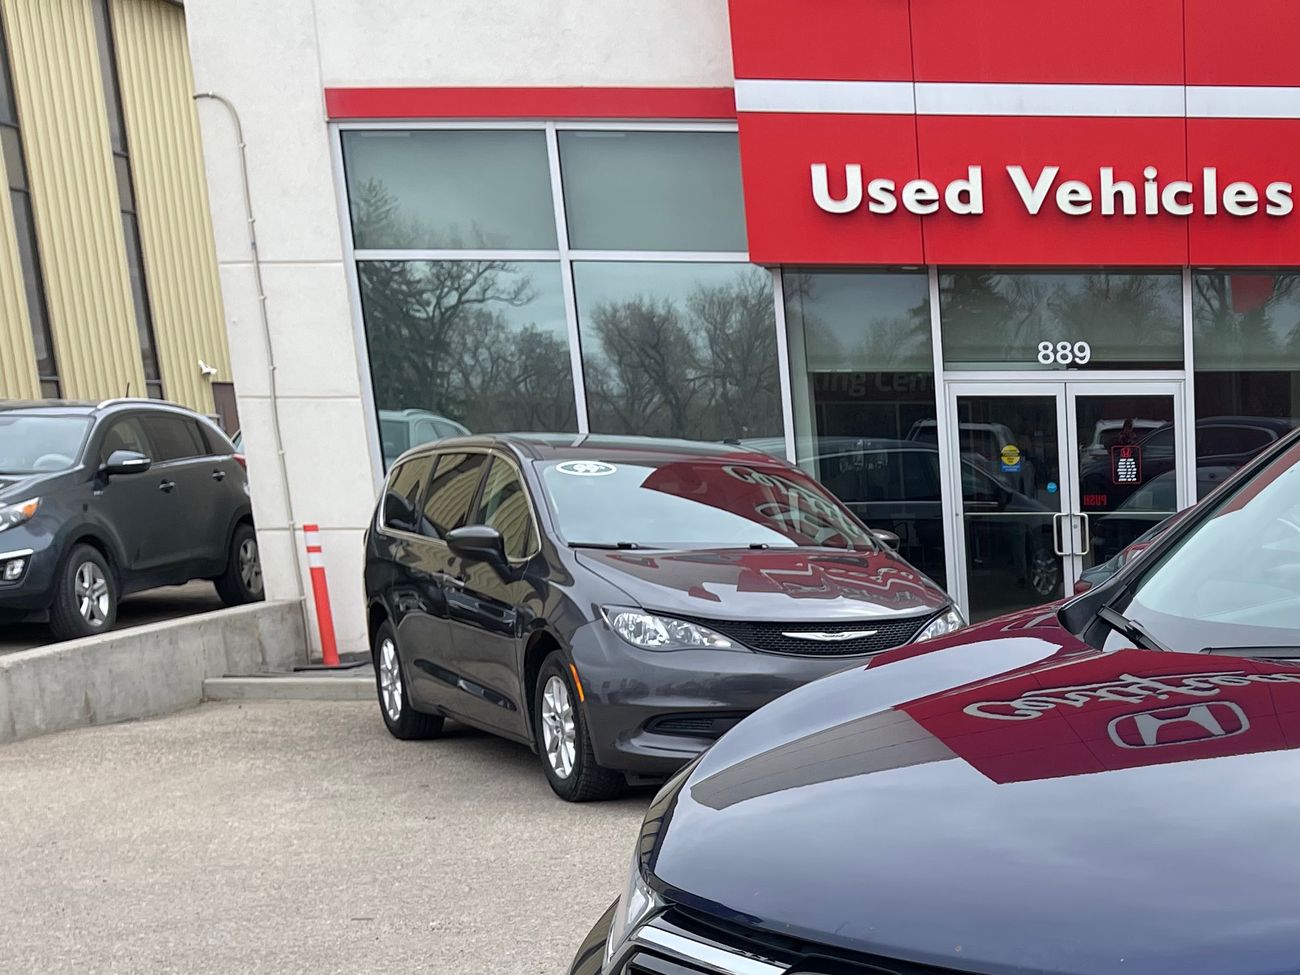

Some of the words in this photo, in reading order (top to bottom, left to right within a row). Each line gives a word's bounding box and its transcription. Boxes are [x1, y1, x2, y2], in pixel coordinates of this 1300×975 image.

[810, 162, 985, 216] Used
[1005, 164, 1295, 217] Vehicles
[1036, 340, 1092, 366] 889
